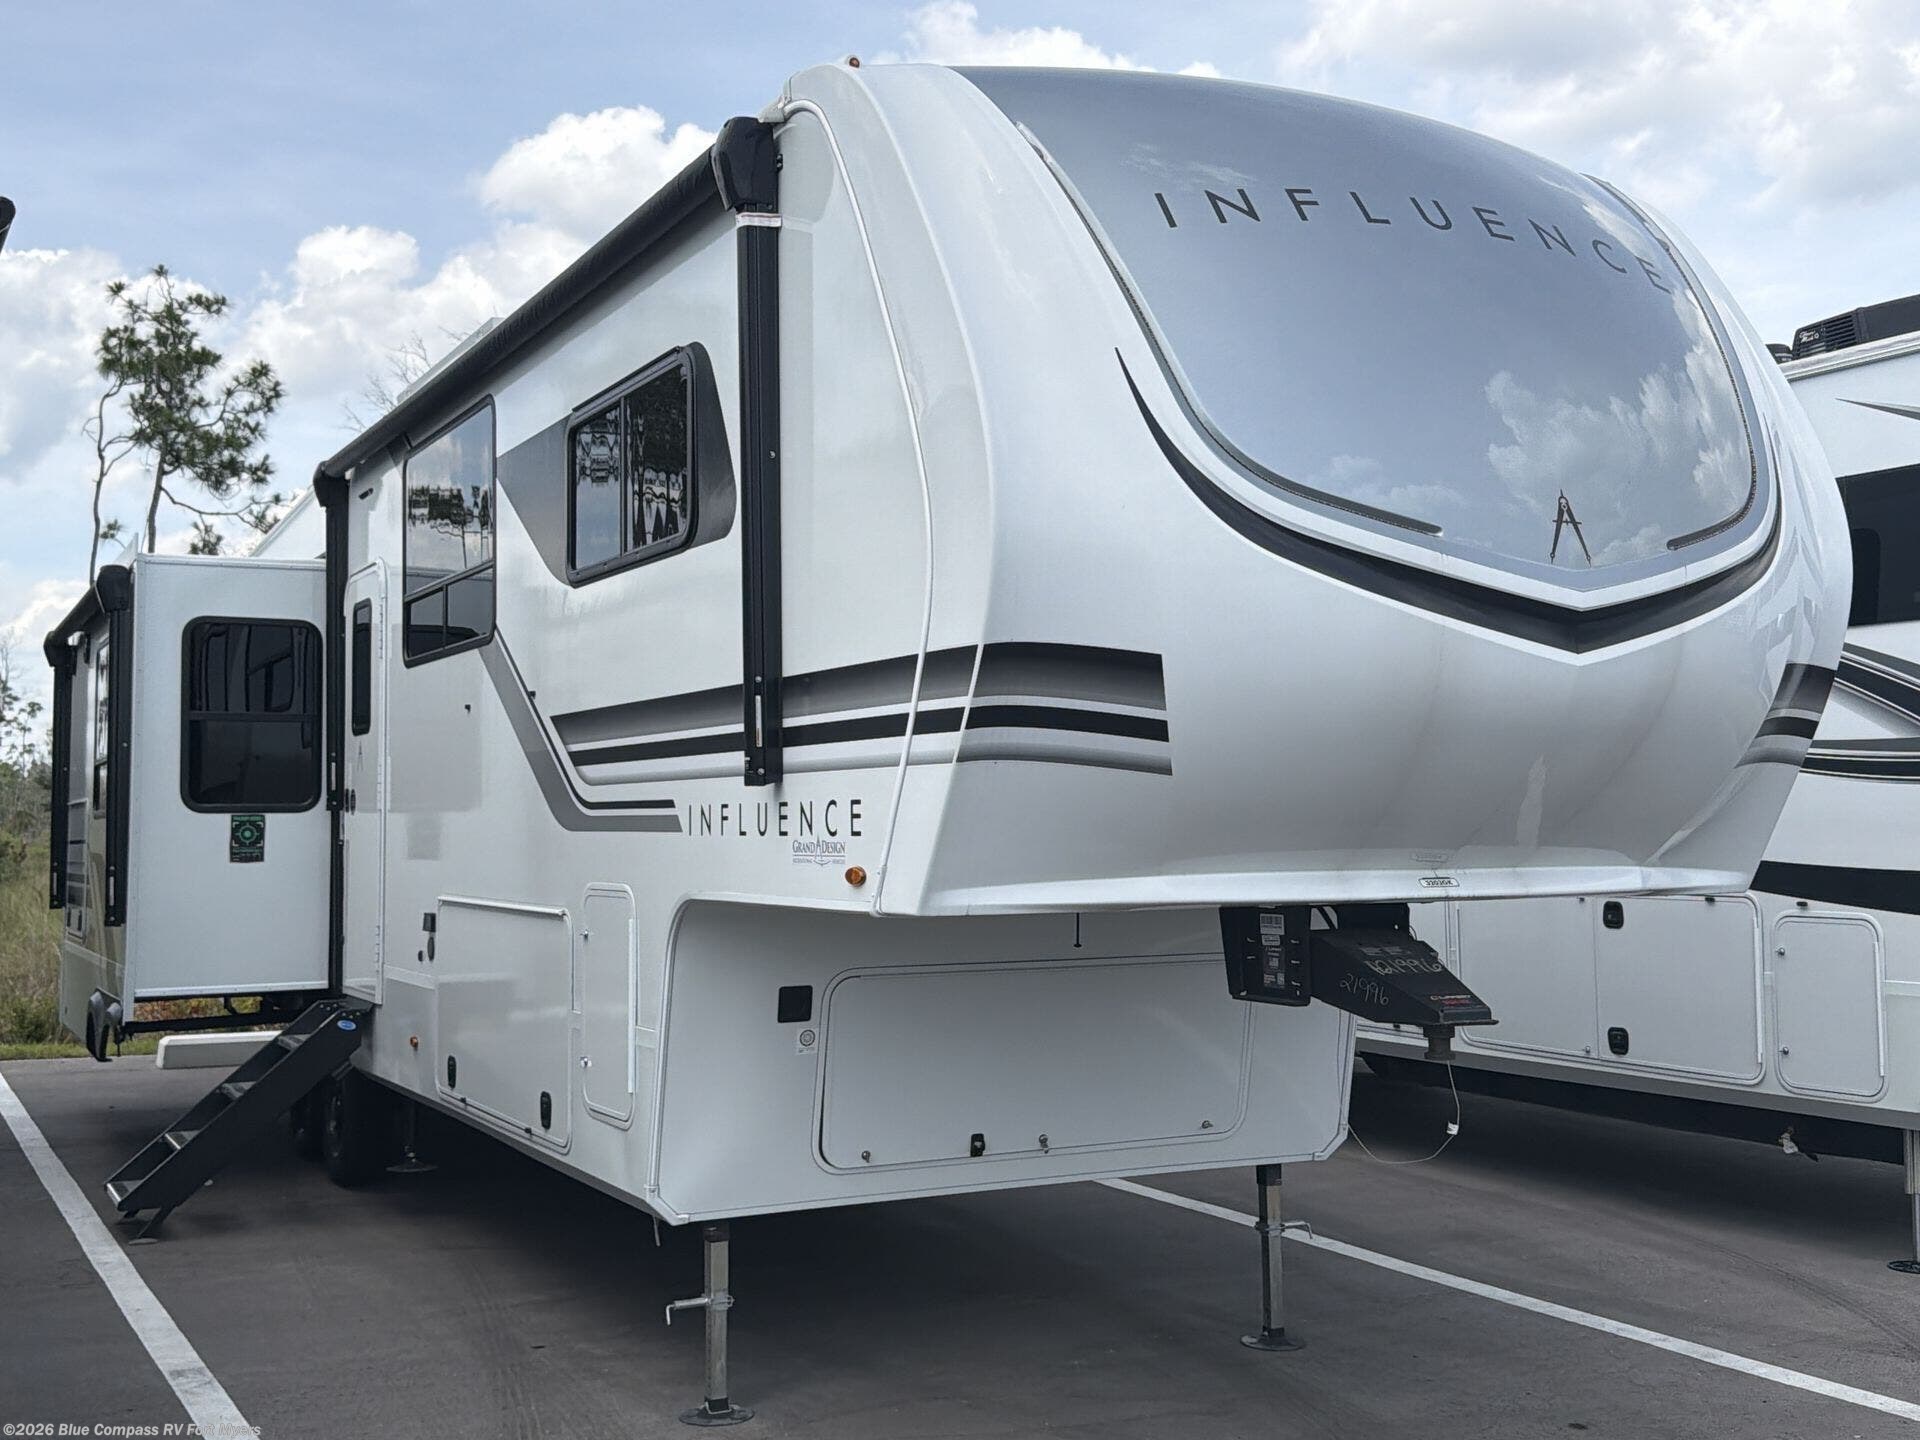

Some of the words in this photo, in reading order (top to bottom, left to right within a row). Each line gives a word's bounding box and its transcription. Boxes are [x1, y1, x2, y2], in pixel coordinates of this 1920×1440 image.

[1153, 187, 1672, 295] INFLUENCE
[688, 799, 862, 837] INFLUENCE
[792, 839, 816, 854] GRAND
[820, 839, 846, 854] DESIGN
[1339, 972, 1389, 1005] 21996
